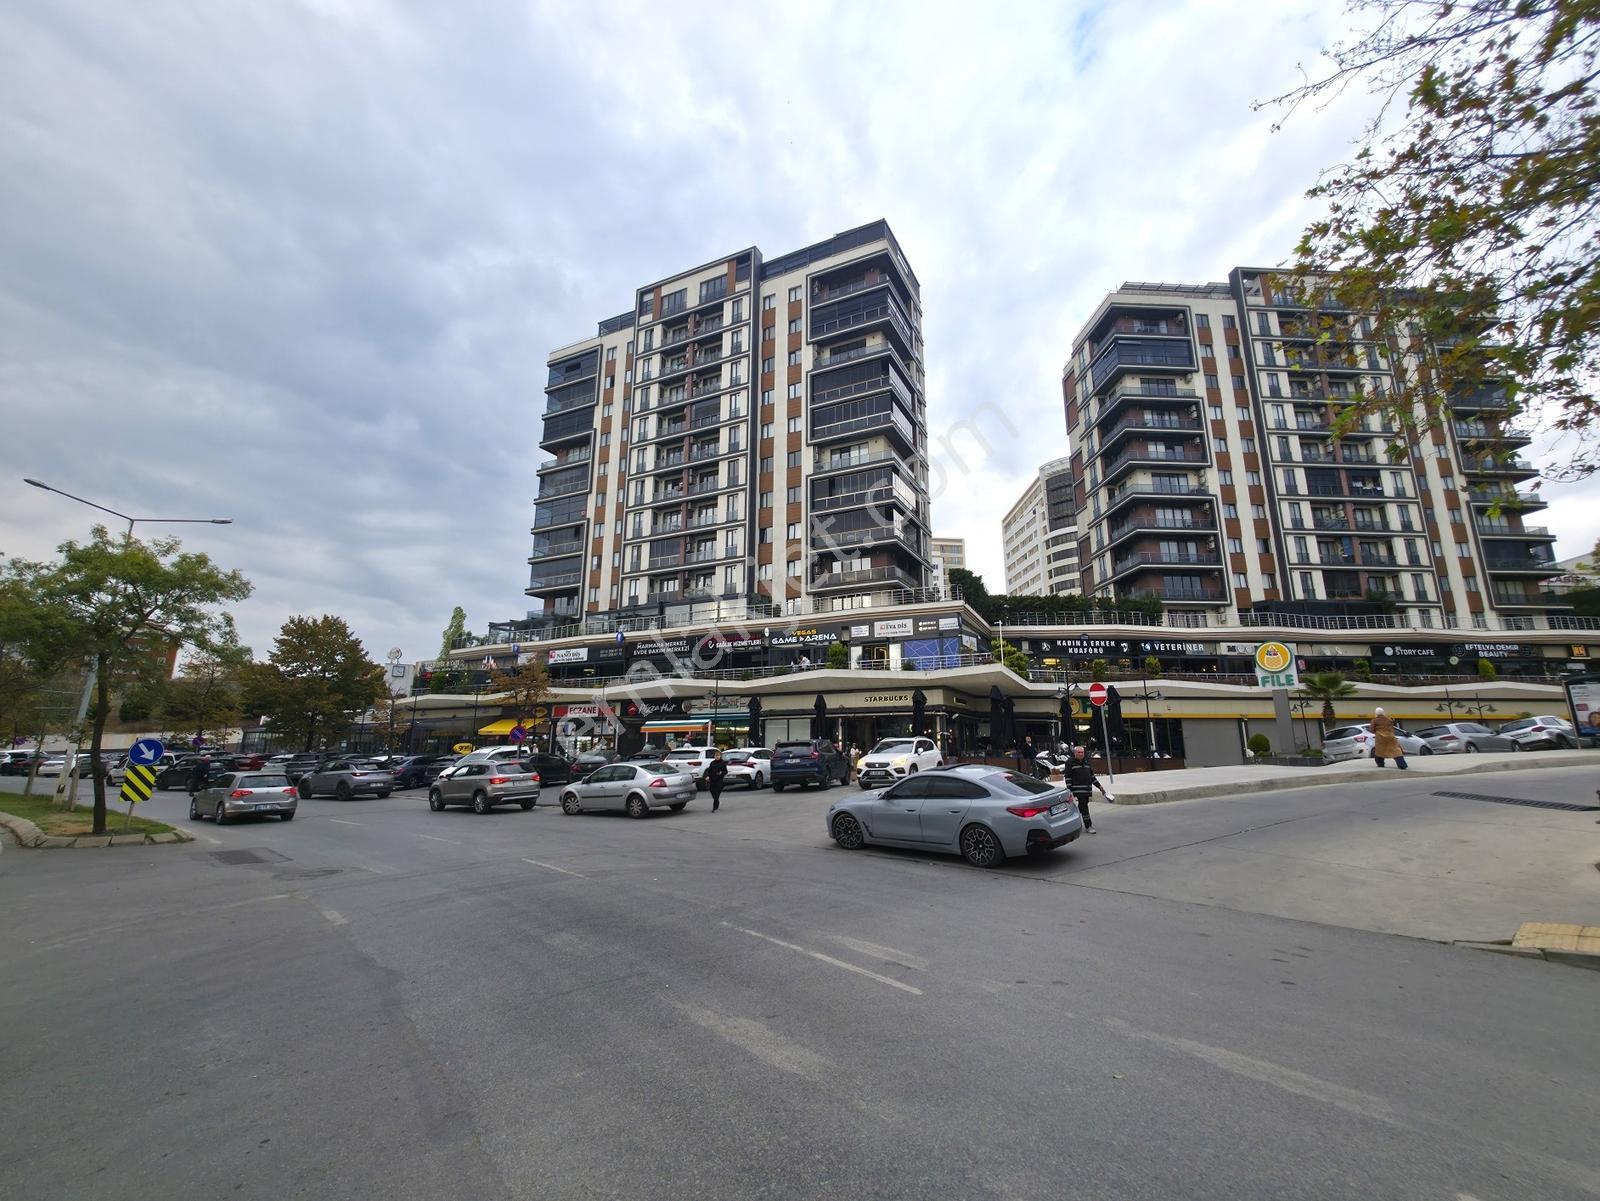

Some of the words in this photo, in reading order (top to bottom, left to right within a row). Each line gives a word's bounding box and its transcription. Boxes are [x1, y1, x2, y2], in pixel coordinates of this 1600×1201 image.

[805, 633, 837, 641] ARENA
[637, 641, 664, 649] MARMARA
[1154, 642, 1204, 651] VETERİNER
[1068, 646, 1104, 654] KUAFÖRÜ
[569, 706, 597, 714] ECZANE
[639, 703, 659, 714] Pizza
[660, 702, 677, 712] Hut
